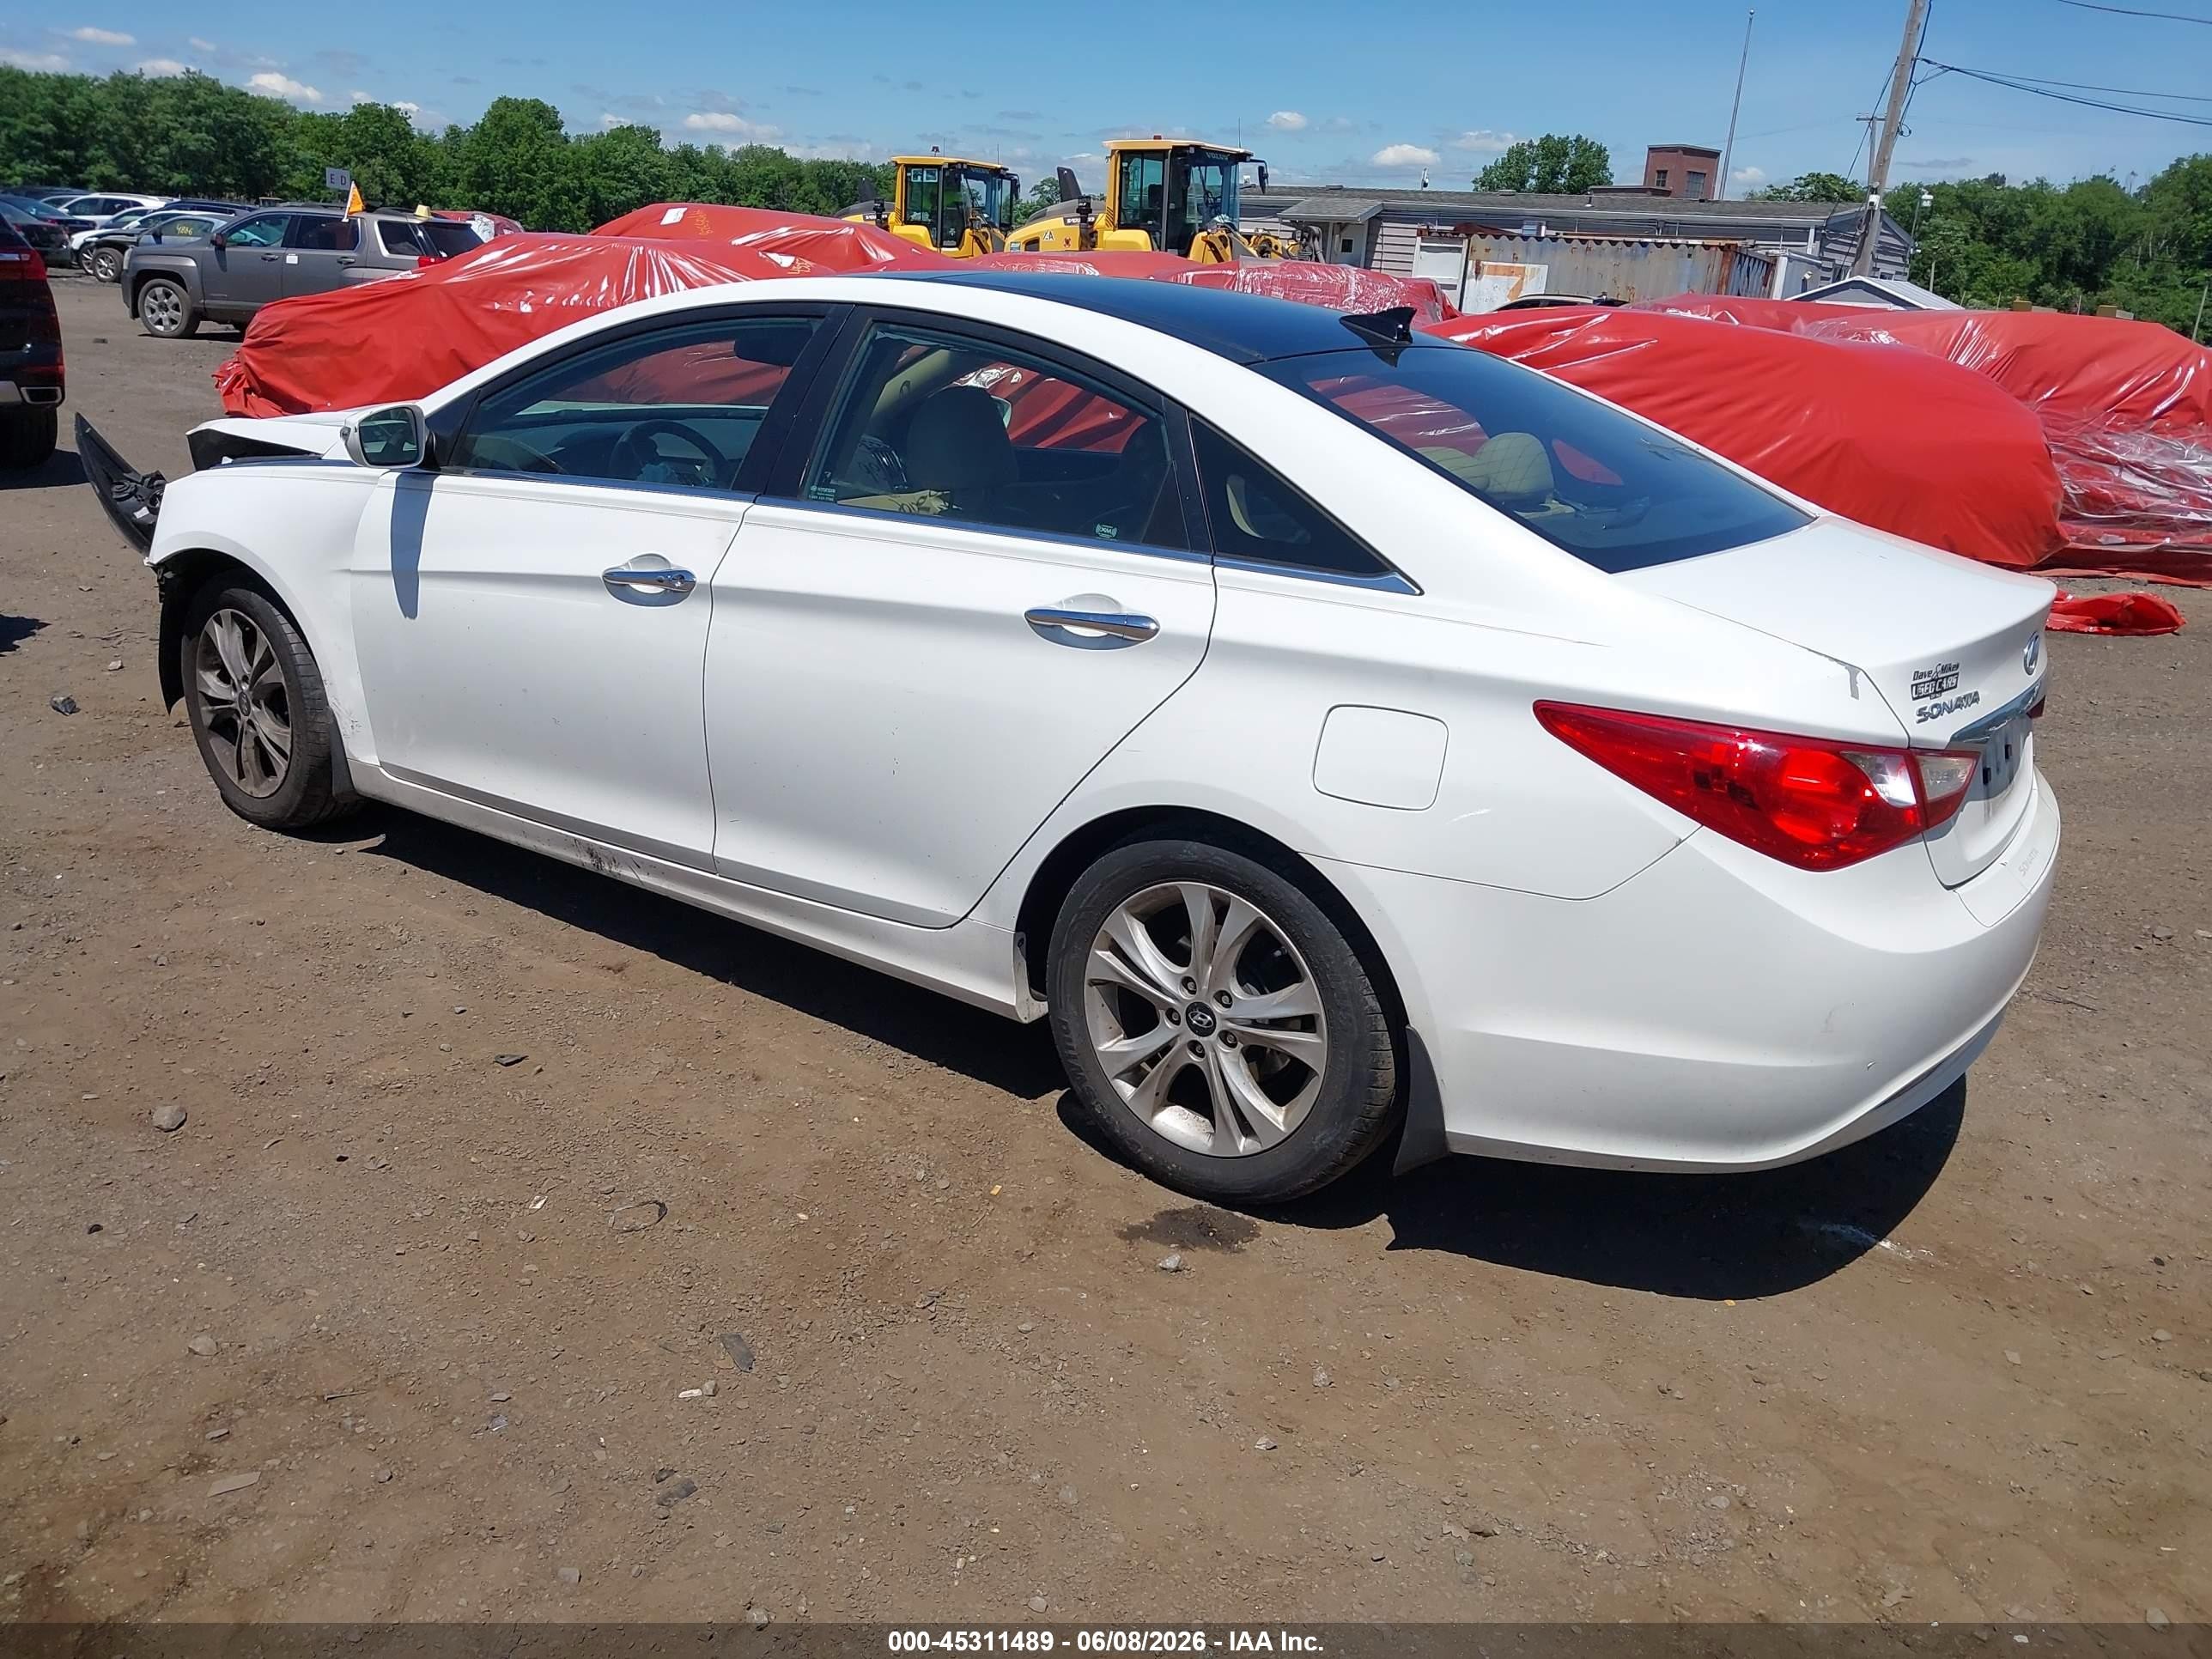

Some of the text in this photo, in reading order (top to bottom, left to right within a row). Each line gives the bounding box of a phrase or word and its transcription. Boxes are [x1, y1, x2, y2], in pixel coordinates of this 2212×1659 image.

[1912, 669, 1932, 681] Dave
[1931, 663, 1942, 679] &
[1936, 675, 1958, 691] CARS
[1916, 690, 1981, 724] SONATA
